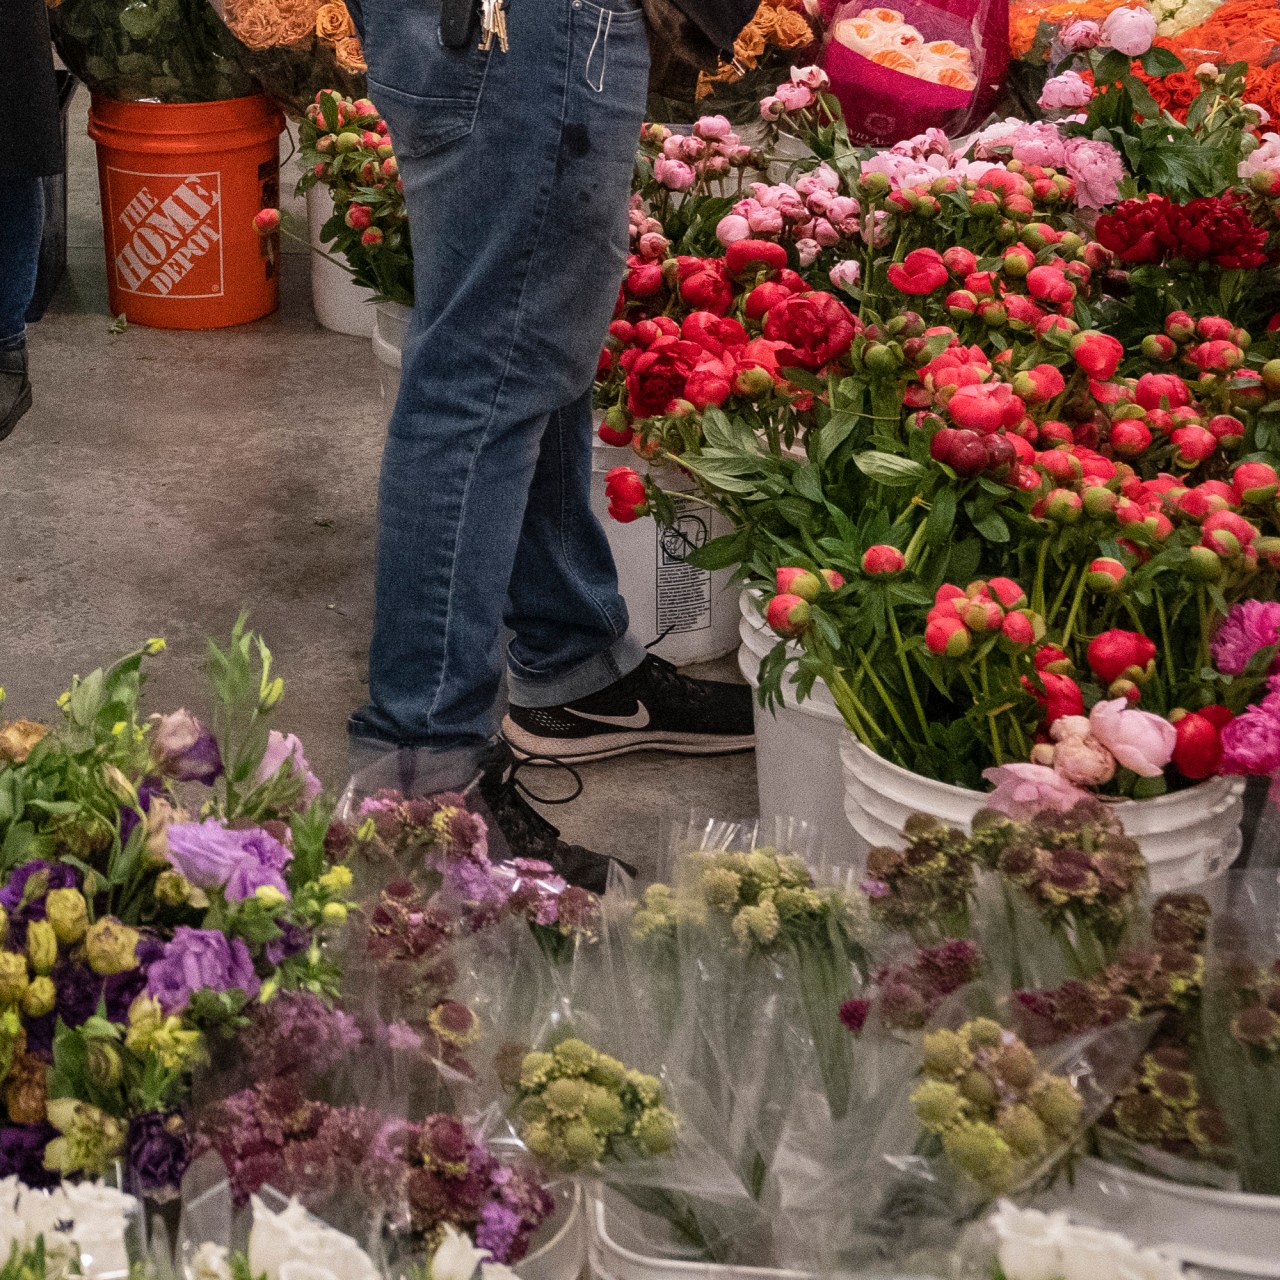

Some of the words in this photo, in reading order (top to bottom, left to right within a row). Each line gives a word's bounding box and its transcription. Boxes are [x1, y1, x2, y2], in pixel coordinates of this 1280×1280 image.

[115, 175, 220, 291] HOME
[119, 186, 159, 232] THE
[150, 219, 220, 296] DEPOT
